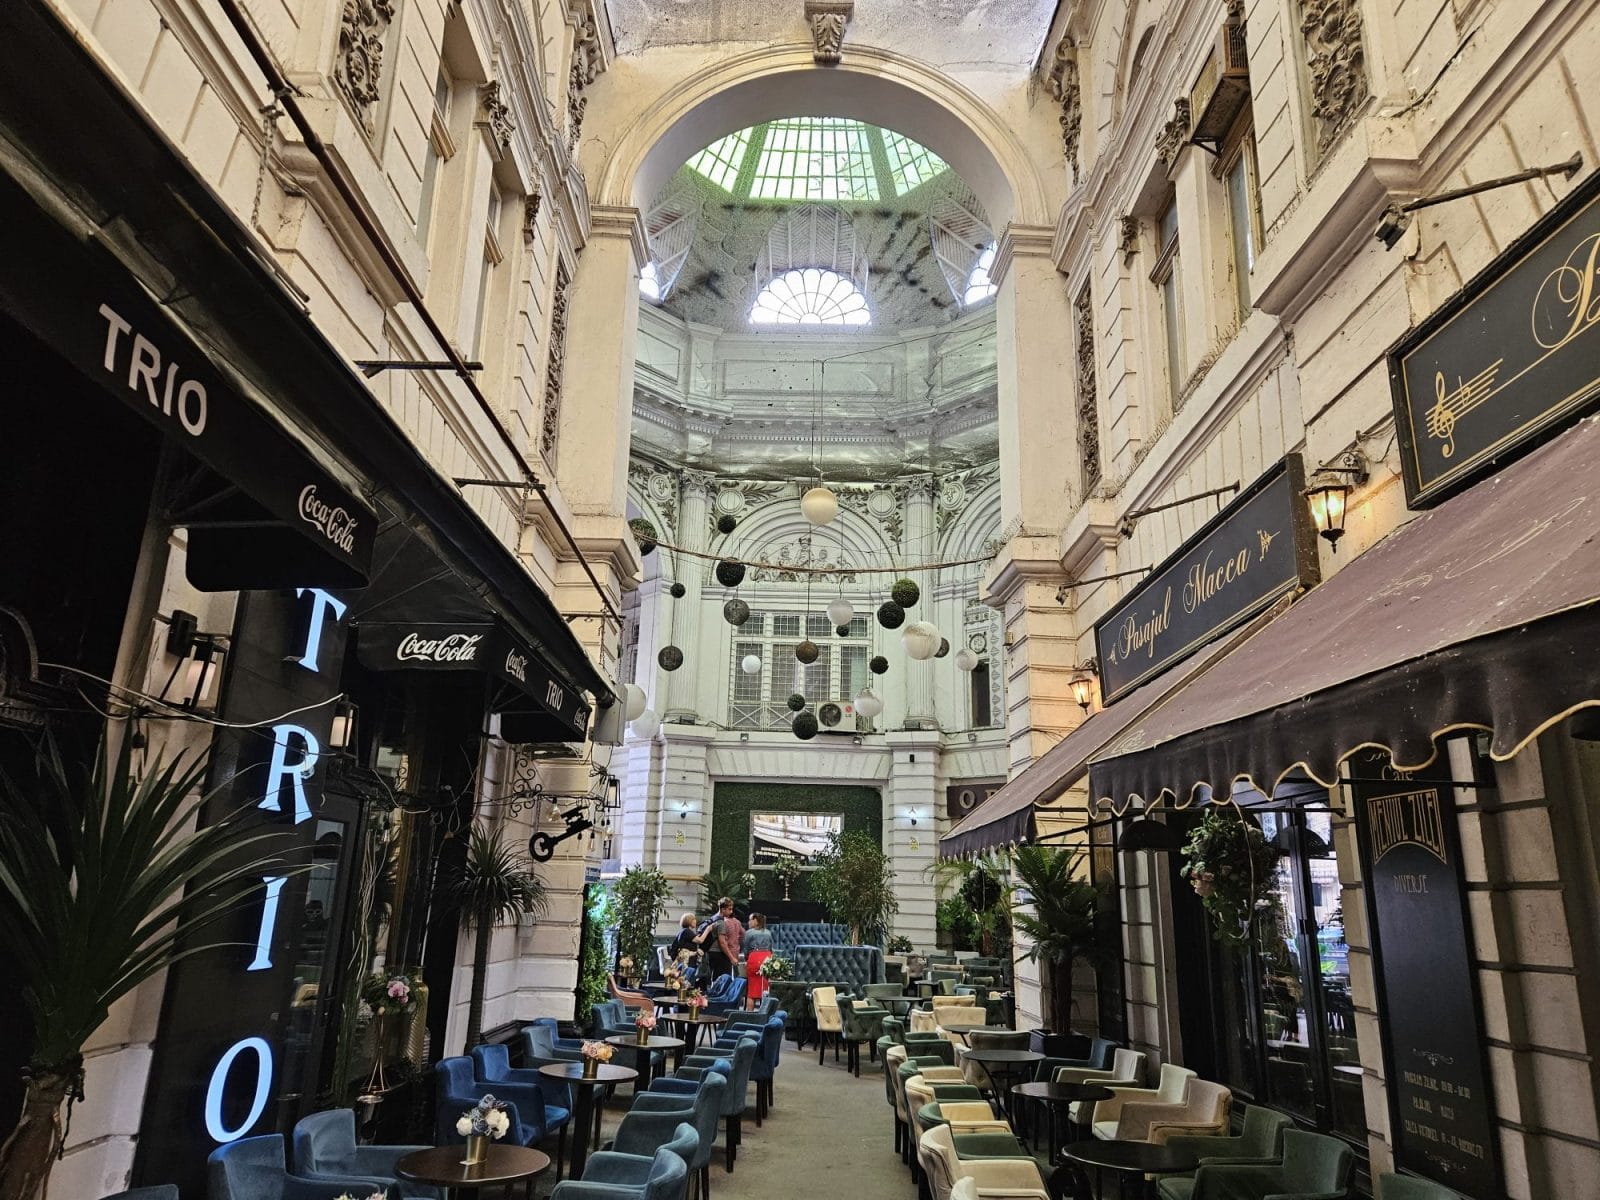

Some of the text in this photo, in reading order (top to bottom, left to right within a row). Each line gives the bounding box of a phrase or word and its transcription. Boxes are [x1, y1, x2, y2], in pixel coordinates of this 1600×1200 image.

[99, 303, 207, 436] TRIO
[298, 484, 358, 555] Coca-Cola
[1119, 548, 1251, 660] Pasajul Macca
[397, 632, 483, 661] Coca-Cola
[546, 680, 563, 711] TRIO
[1407, 791, 1444, 858] ZILEI
[203, 588, 347, 1143] TRIO
